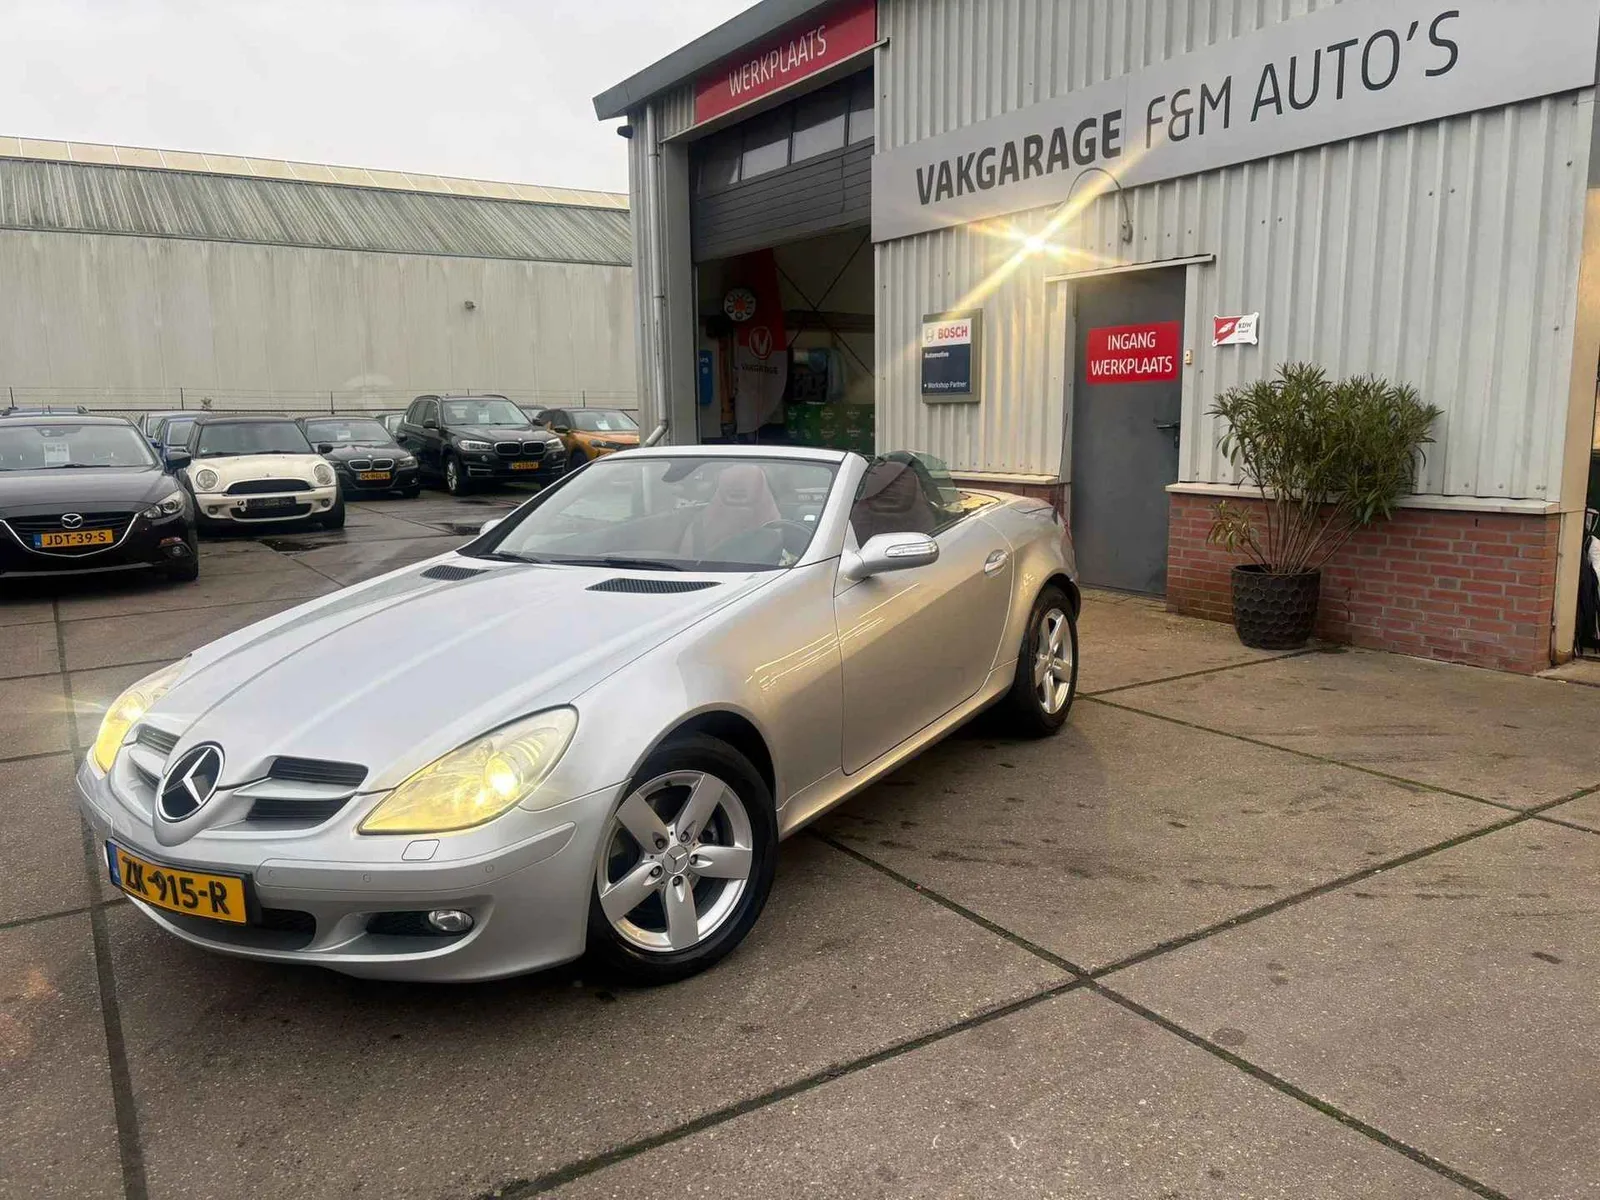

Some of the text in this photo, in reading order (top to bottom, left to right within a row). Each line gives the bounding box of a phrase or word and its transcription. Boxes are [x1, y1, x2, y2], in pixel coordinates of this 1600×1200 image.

[728, 25, 827, 97] WERKPLAATS
[916, 10, 1460, 206] VAKGARAGE F&M AUTO'S
[938, 325, 968, 340] BOSCH
[1107, 331, 1157, 351] INGANG
[1091, 355, 1173, 376] WERKPLAATS
[950, 380, 968, 388] Partner
[46, 531, 106, 546] JDT-39-S
[121, 855, 230, 915] ZK-915-R
